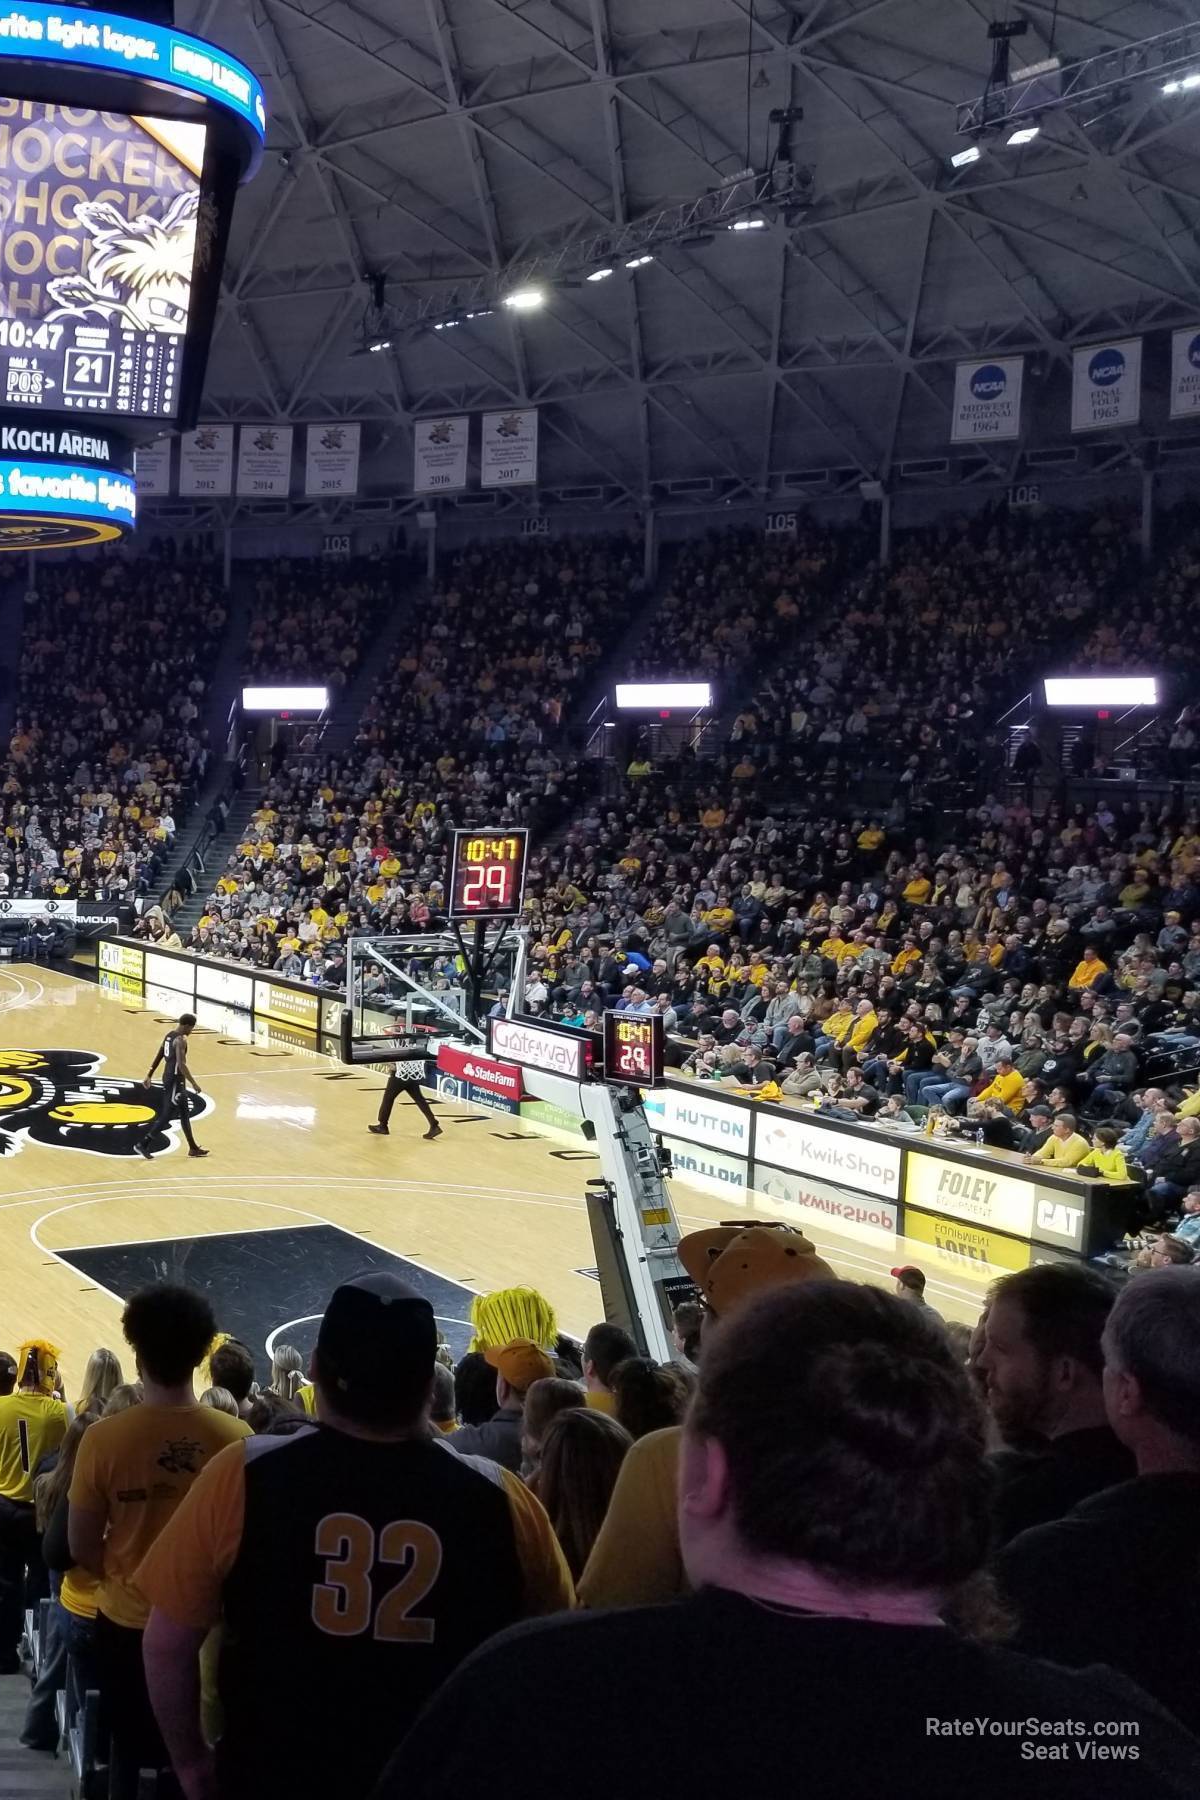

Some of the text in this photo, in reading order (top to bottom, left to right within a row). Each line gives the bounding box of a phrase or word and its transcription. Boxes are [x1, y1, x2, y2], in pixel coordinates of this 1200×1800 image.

[47, 17, 99, 48] light
[7, 372, 43, 393] POS
[73, 356, 103, 384] 21
[1, 427, 56, 453] KOCH
[58, 434, 110, 460] ARENA
[8, 468, 97, 503] favorite
[466, 839, 517, 862] 10:47
[463, 865, 506, 906] 29
[620, 1045, 646, 1071] 29
[676, 1106, 744, 1139] HUTTON
[938, 1168, 998, 1205] FOLEY
[1037, 1198, 1083, 1238] CAT
[18, 1419, 30, 1473] 1
[312, 1512, 442, 1643] 32
